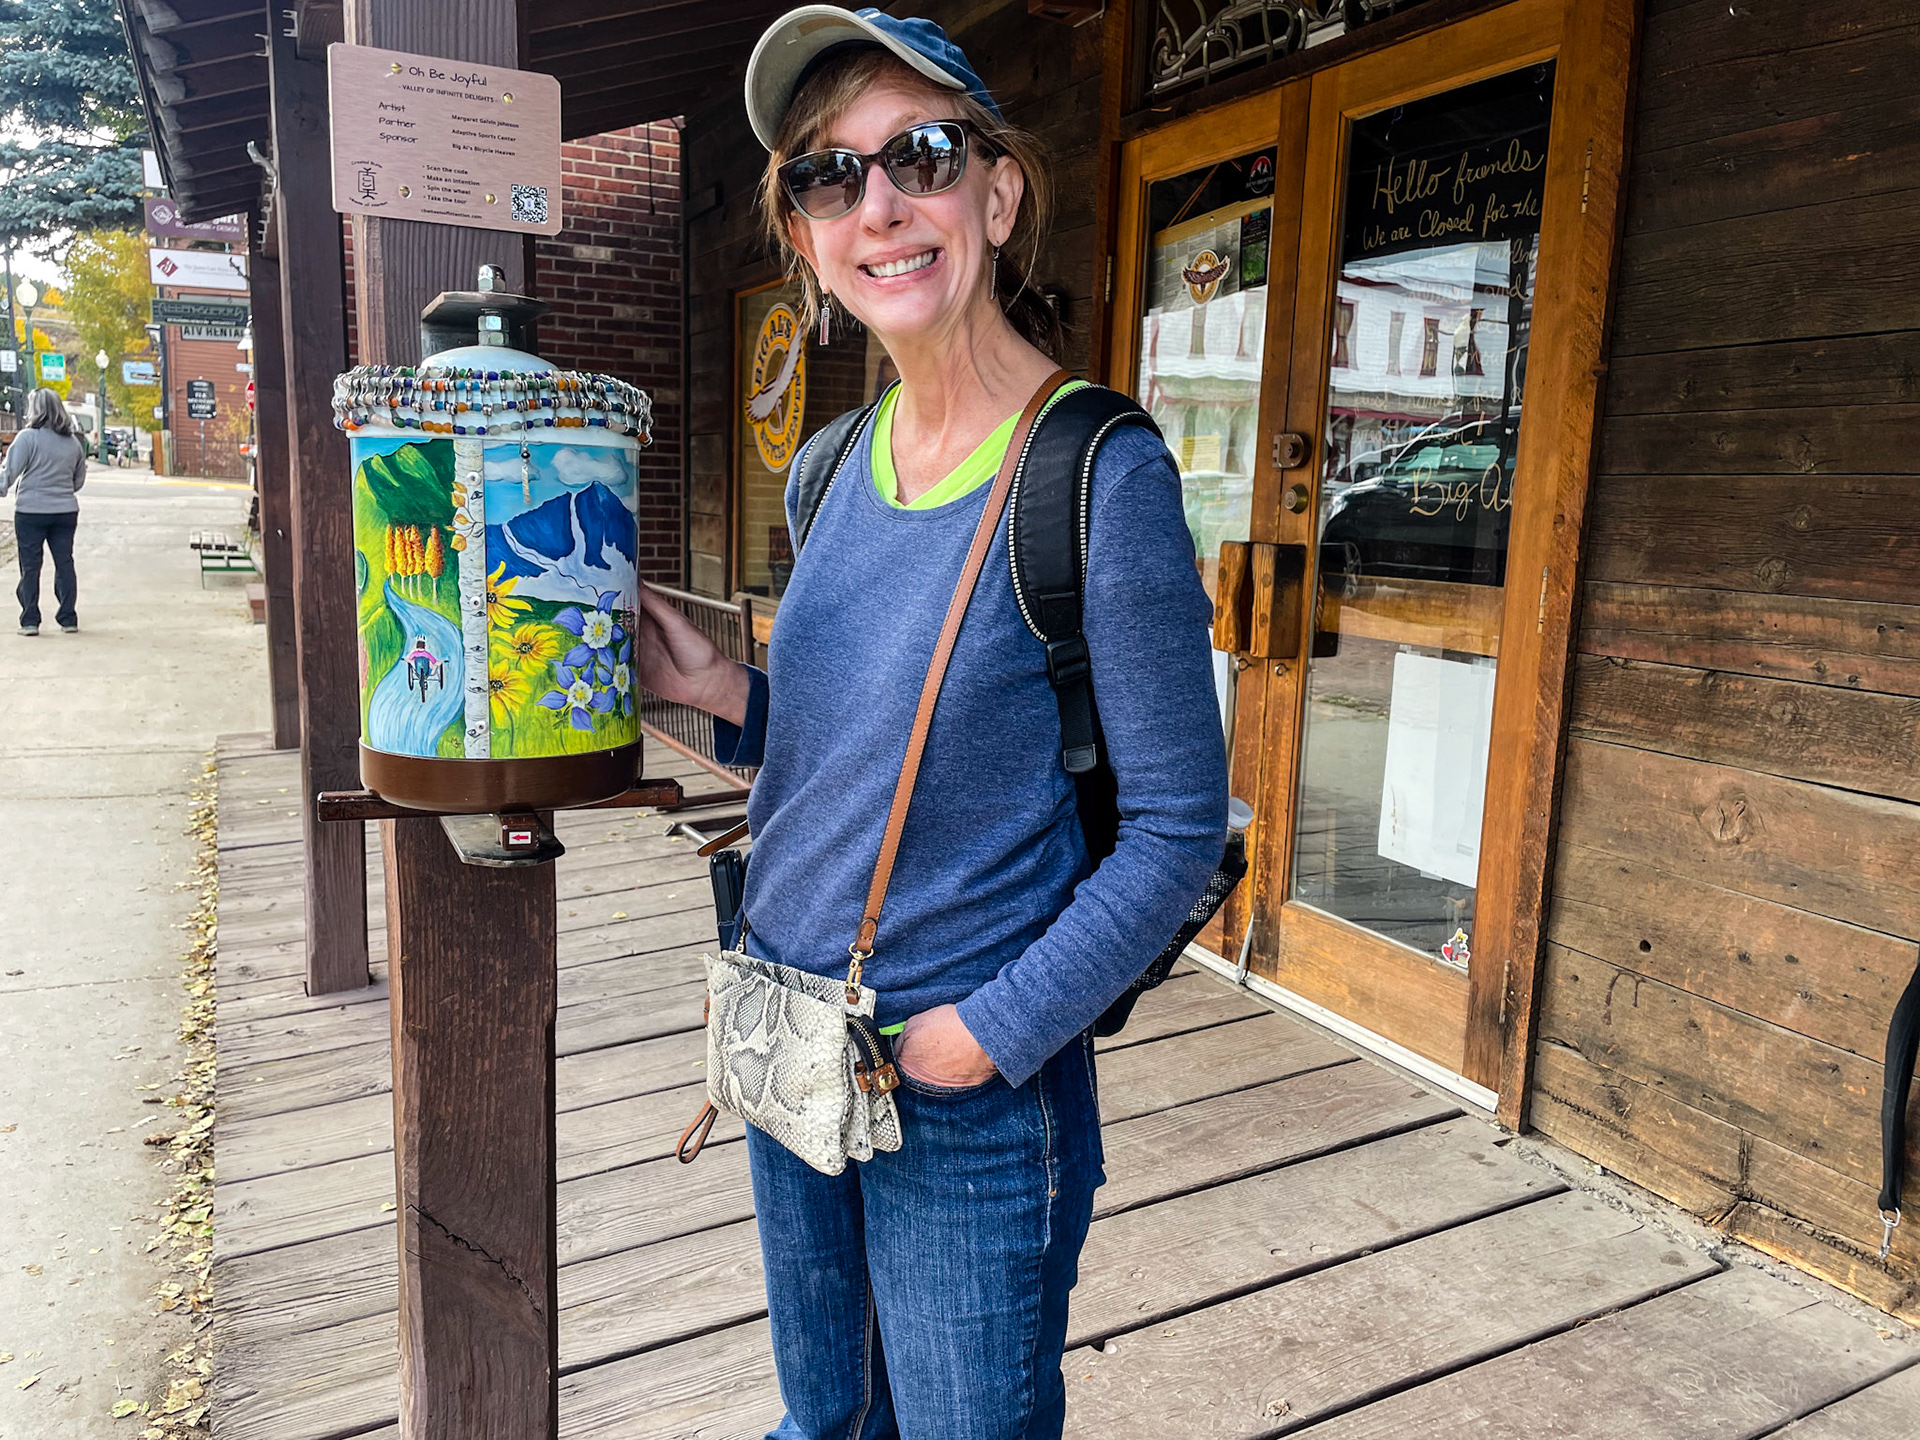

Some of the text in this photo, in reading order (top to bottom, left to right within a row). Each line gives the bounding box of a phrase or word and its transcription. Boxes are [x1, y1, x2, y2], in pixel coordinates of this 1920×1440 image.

[408, 66, 487, 88] Oh Be Joyful
[402, 84, 424, 93] VALLEY
[436, 89, 462, 98] INFINITE
[465, 93, 494, 103] DELIGHTS
[378, 102, 405, 112] Artist
[379, 117, 416, 128] Partner
[379, 132, 418, 143] Sponsor
[1372, 138, 1544, 214] Hello friends
[1363, 189, 1540, 250] We are Closed for the
[755, 314, 792, 386] BIG AL'S
[1409, 462, 1478, 522] Big
